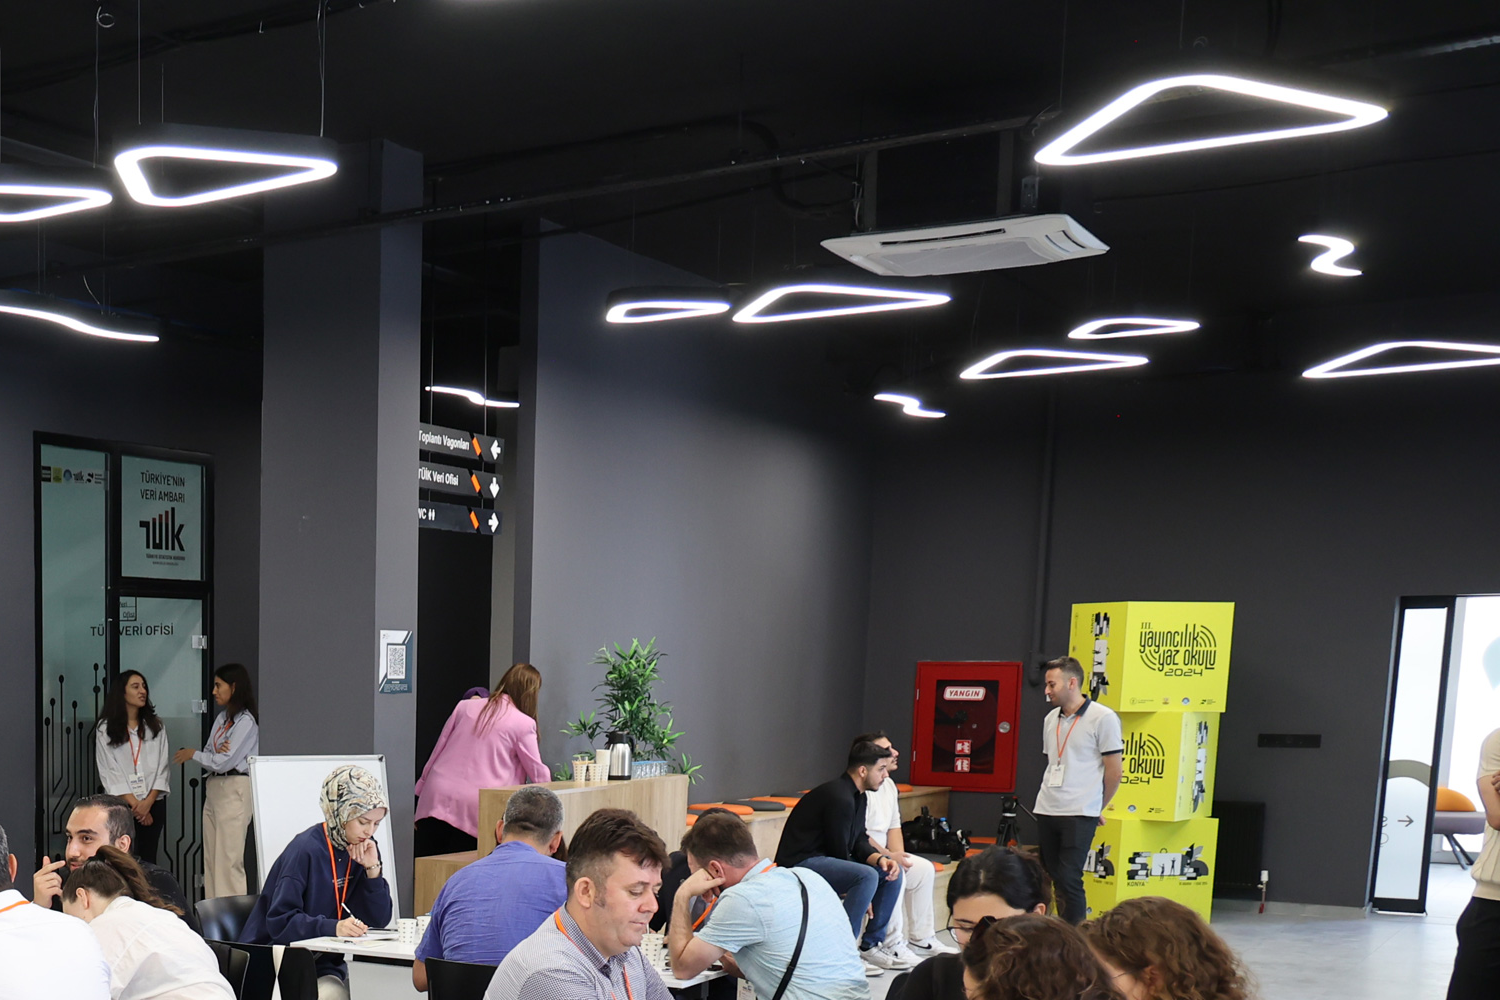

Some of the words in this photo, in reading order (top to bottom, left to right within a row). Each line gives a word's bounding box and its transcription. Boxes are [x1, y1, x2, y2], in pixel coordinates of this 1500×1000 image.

[432, 471, 444, 482] Veri
[445, 474, 459, 486] Ofisi
[157, 491, 185, 504] AMBARI
[1164, 668, 1203, 677] 2024
[949, 689, 980, 697] YANGIN
